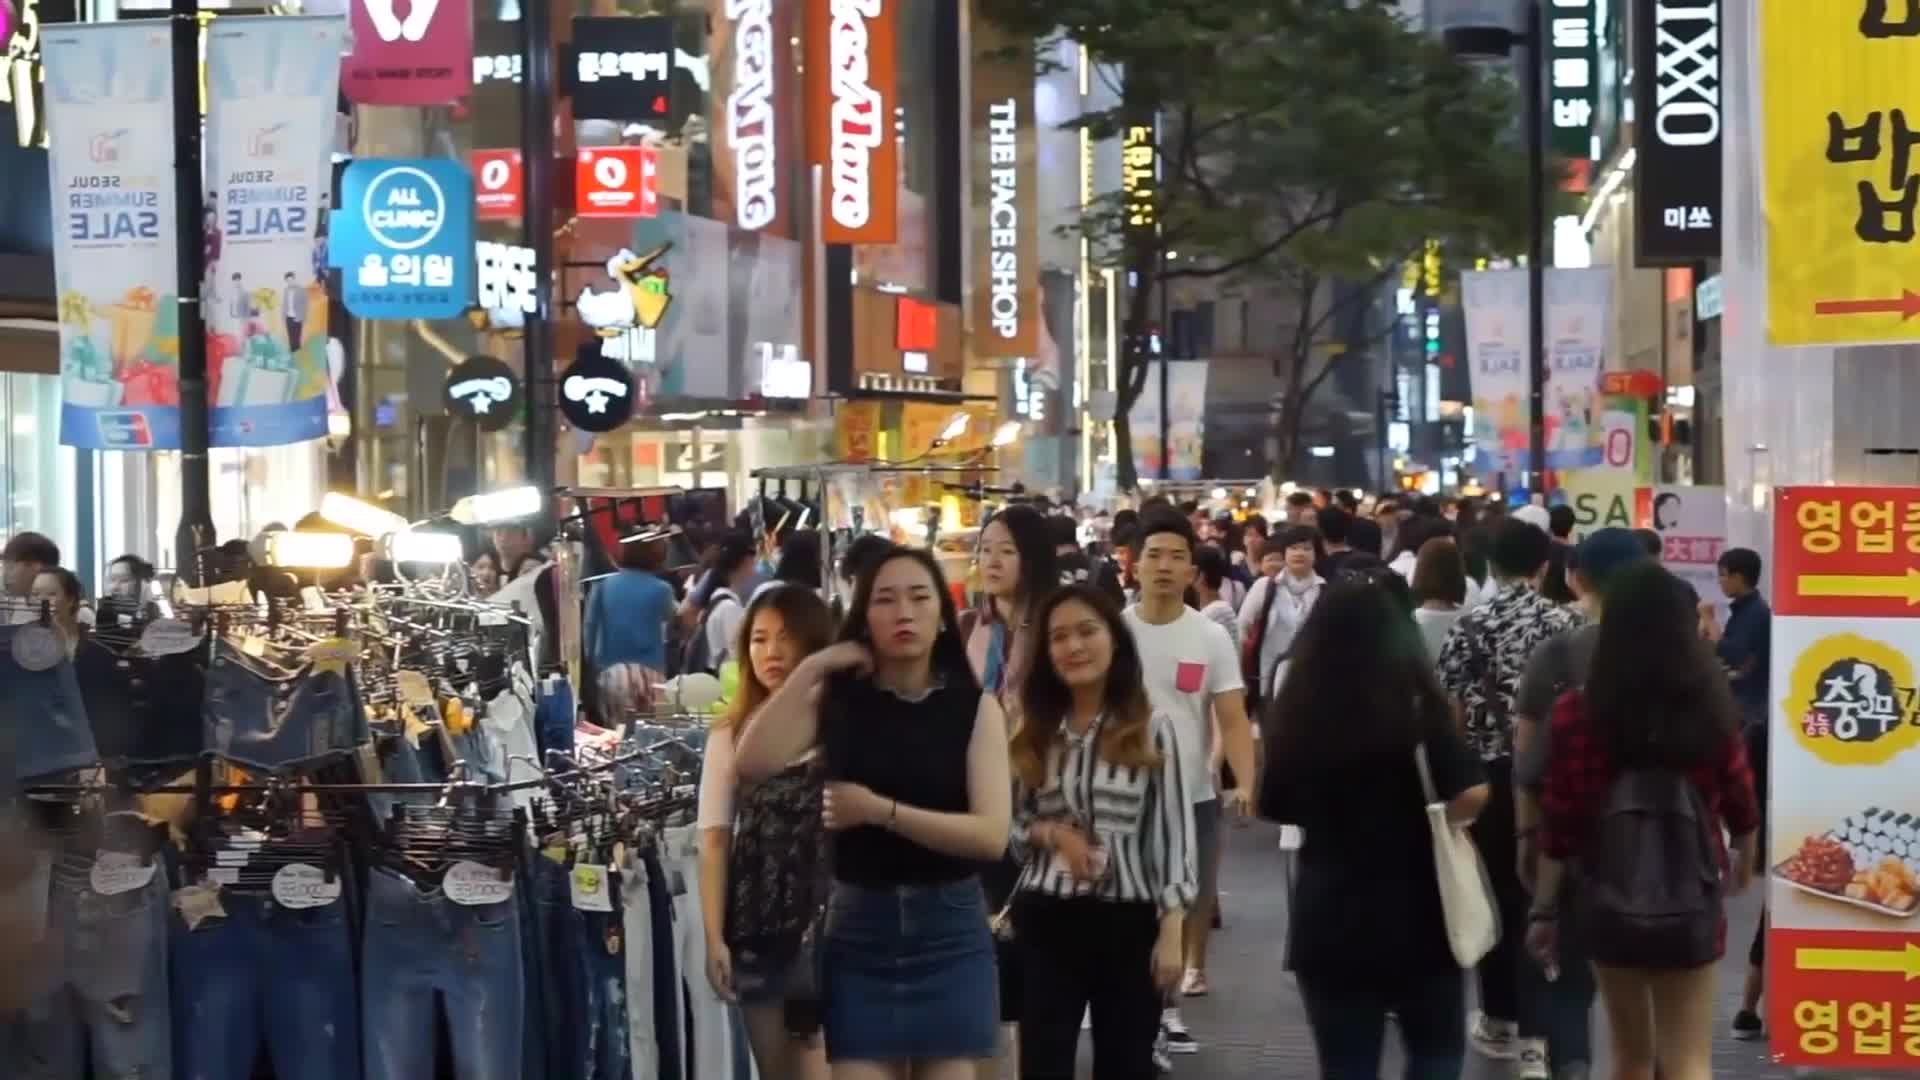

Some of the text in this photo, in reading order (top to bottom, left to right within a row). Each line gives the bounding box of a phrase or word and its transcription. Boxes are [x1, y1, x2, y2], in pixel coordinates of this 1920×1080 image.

[1656, 0, 1719, 145] IXXO
[387, 188, 421, 205] ALL
[989, 98, 1018, 338] THE FACE SHOP
